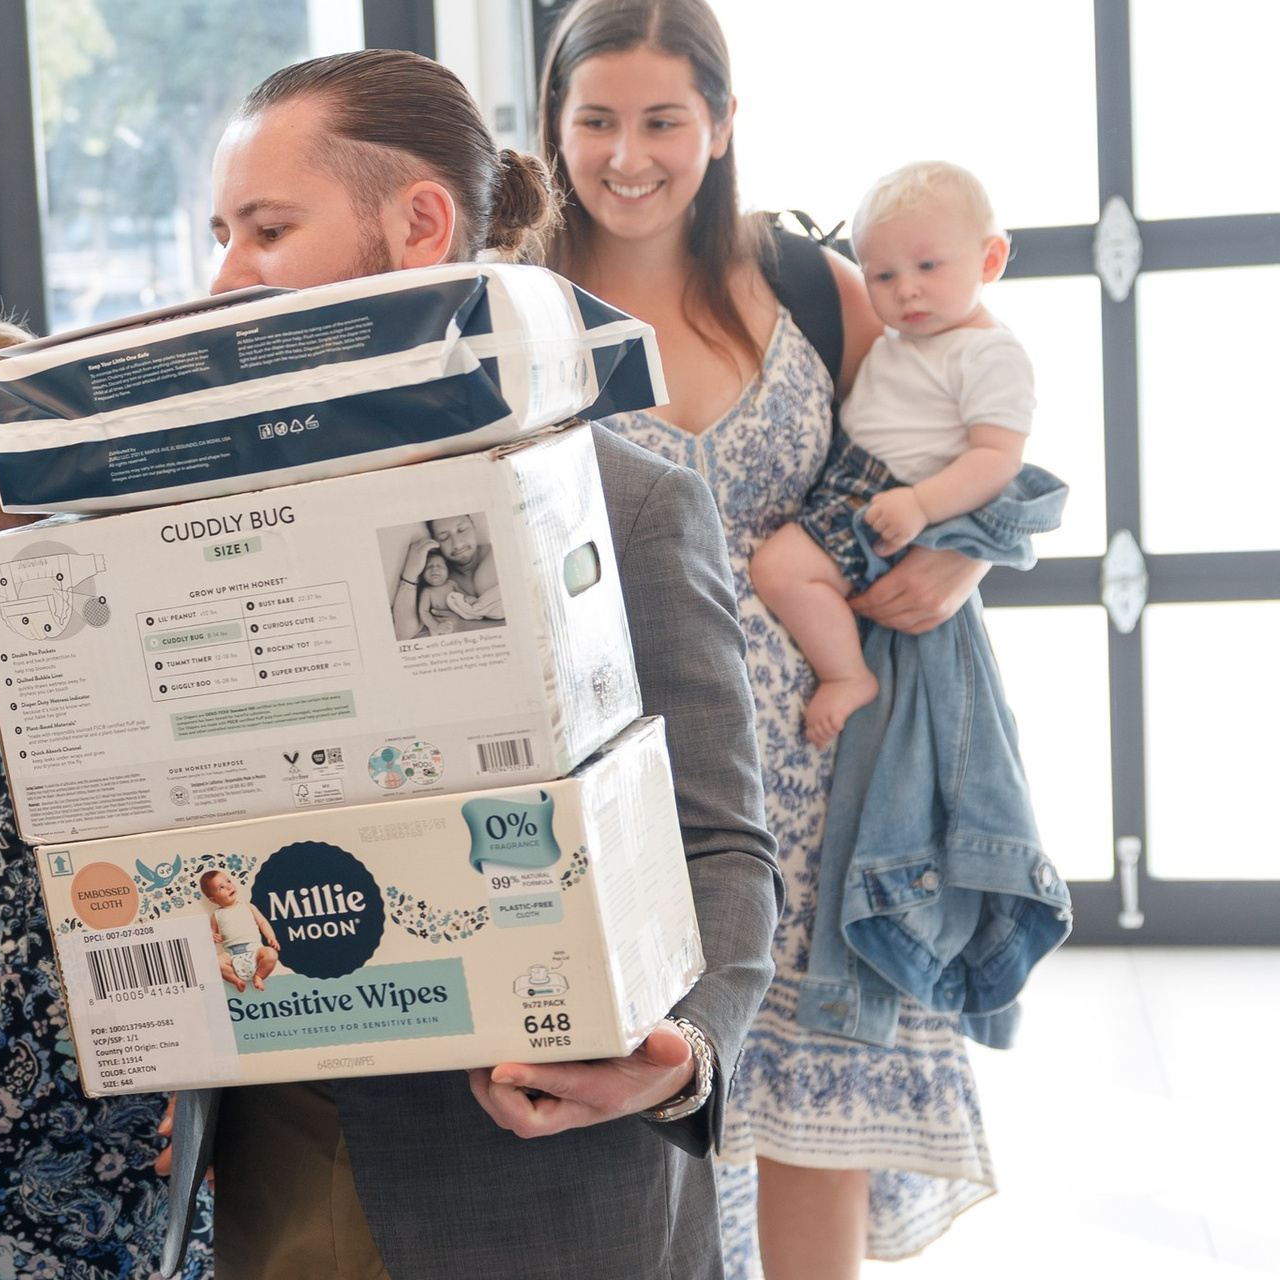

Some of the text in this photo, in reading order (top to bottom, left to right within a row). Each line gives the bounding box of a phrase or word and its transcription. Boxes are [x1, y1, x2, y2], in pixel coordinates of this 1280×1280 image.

[236, 328, 259, 337] Disposal
[161, 506, 295, 543] CUDDLY BUG
[214, 542, 250, 557] SIZE 1
[189, 588, 214, 598] GROW
[216, 586, 227, 594] UP
[228, 583, 249, 592] WITH
[258, 600, 275, 608] BUSY
[277, 597, 295, 605] BABE
[170, 612, 196, 621] PEANUT
[262, 620, 294, 630] CURIOUS
[295, 617, 315, 625] CUTIE
[162, 636, 188, 645] CUDDLY
[267, 644, 295, 652] ROCKIN'
[400, 645, 412, 653] IZY
[166, 659, 190, 667] TUMMY
[191, 656, 212, 664] TIMER
[271, 668, 293, 676] SUPER
[294, 663, 329, 673] EXPLORER
[171, 682, 194, 691] GIGGLY
[185, 764, 211, 772] HONEST
[213, 760, 244, 768] PURPOSE
[486, 812, 538, 840] 0%
[490, 840, 540, 850] FRAGRANCE
[521, 872, 550, 880] NATURAL
[491, 875, 520, 890] 99%
[522, 879, 554, 887] FORMULA
[78, 886, 130, 900] EMBOSSED
[90, 899, 123, 911] CLOTH
[268, 884, 366, 921] Millie
[499, 901, 553, 912] PLASTIC-FREE
[516, 911, 540, 919] CLOTH
[83, 927, 154, 944] DPCI: 007-07-0208
[109, 990, 144, 1003] 10005
[150, 985, 186, 997] 41431
[228, 982, 448, 1022] Sensitive Wipes
[522, 999, 566, 1009] 9x72 PACK
[243, 1016, 439, 1040] CLINICALLY TESTED FOR SENSITIVE SKIN
[524, 1013, 571, 1034] 648
[93, 1034, 139, 1046] VCP/SSP: 1/1
[529, 1036, 572, 1048] WIPES
[96, 1041, 180, 1057] Country Of Origin: China
[98, 1056, 143, 1068] STYLE: 11914
[100, 1065, 157, 1078] COLOR: CARTON
[102, 1080, 120, 1088] SIZE:
